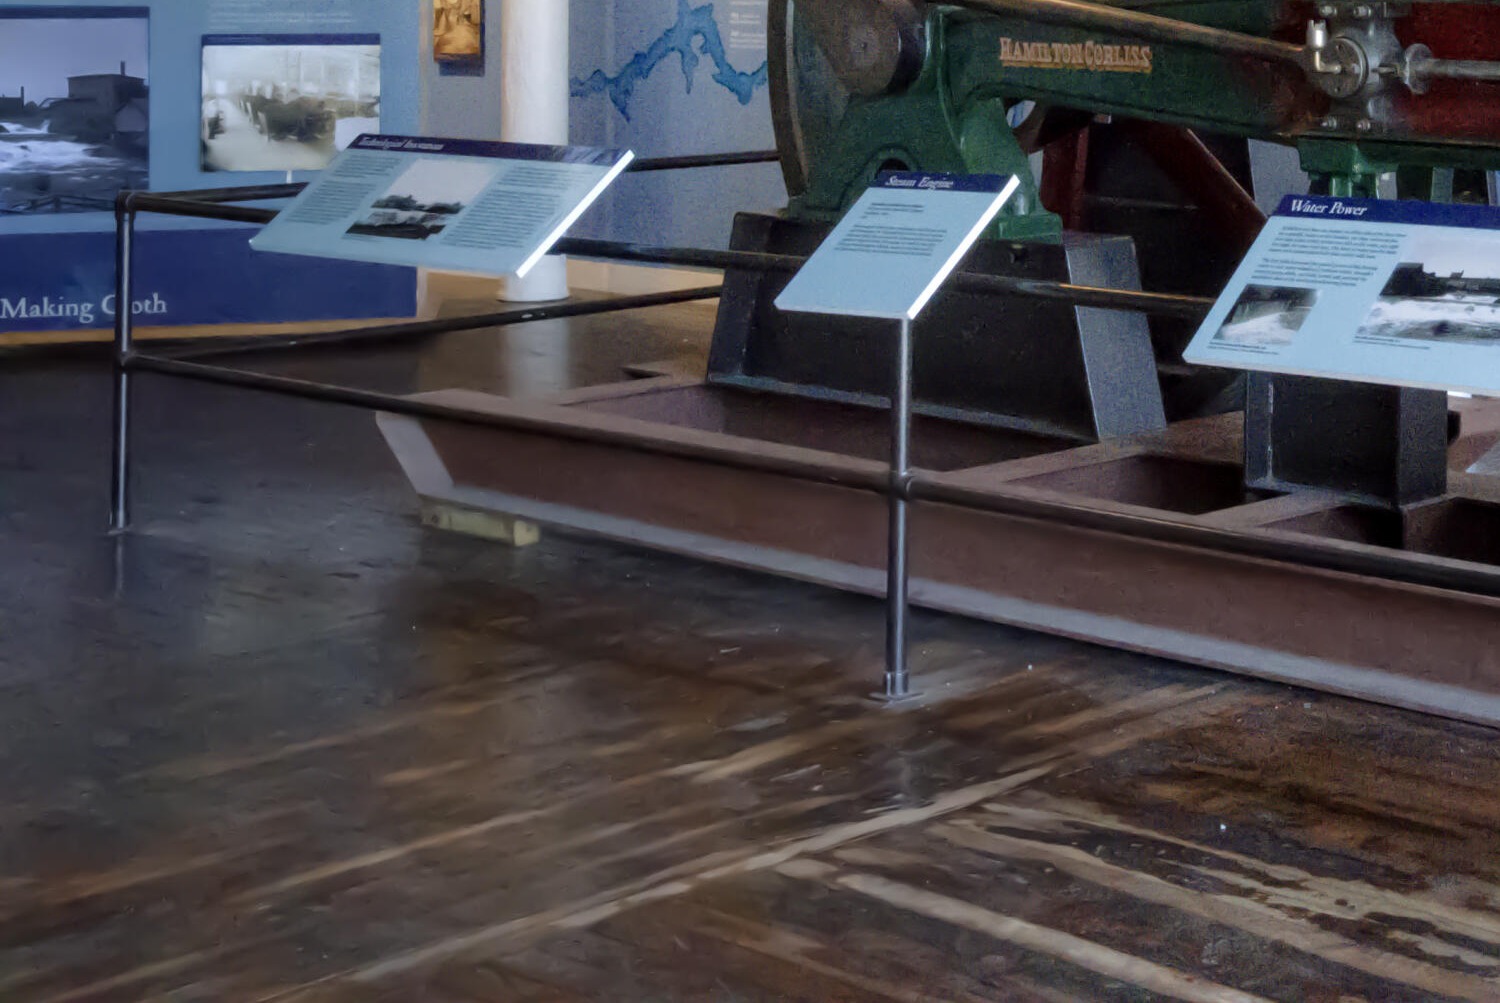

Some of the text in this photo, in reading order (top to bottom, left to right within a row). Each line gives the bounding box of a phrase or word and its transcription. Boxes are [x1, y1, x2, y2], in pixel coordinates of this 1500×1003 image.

[999, 37, 1153, 72] HAMILTON CORLISS
[1290, 198, 1368, 216] Water Power
[0, 291, 168, 324] Making Coth
